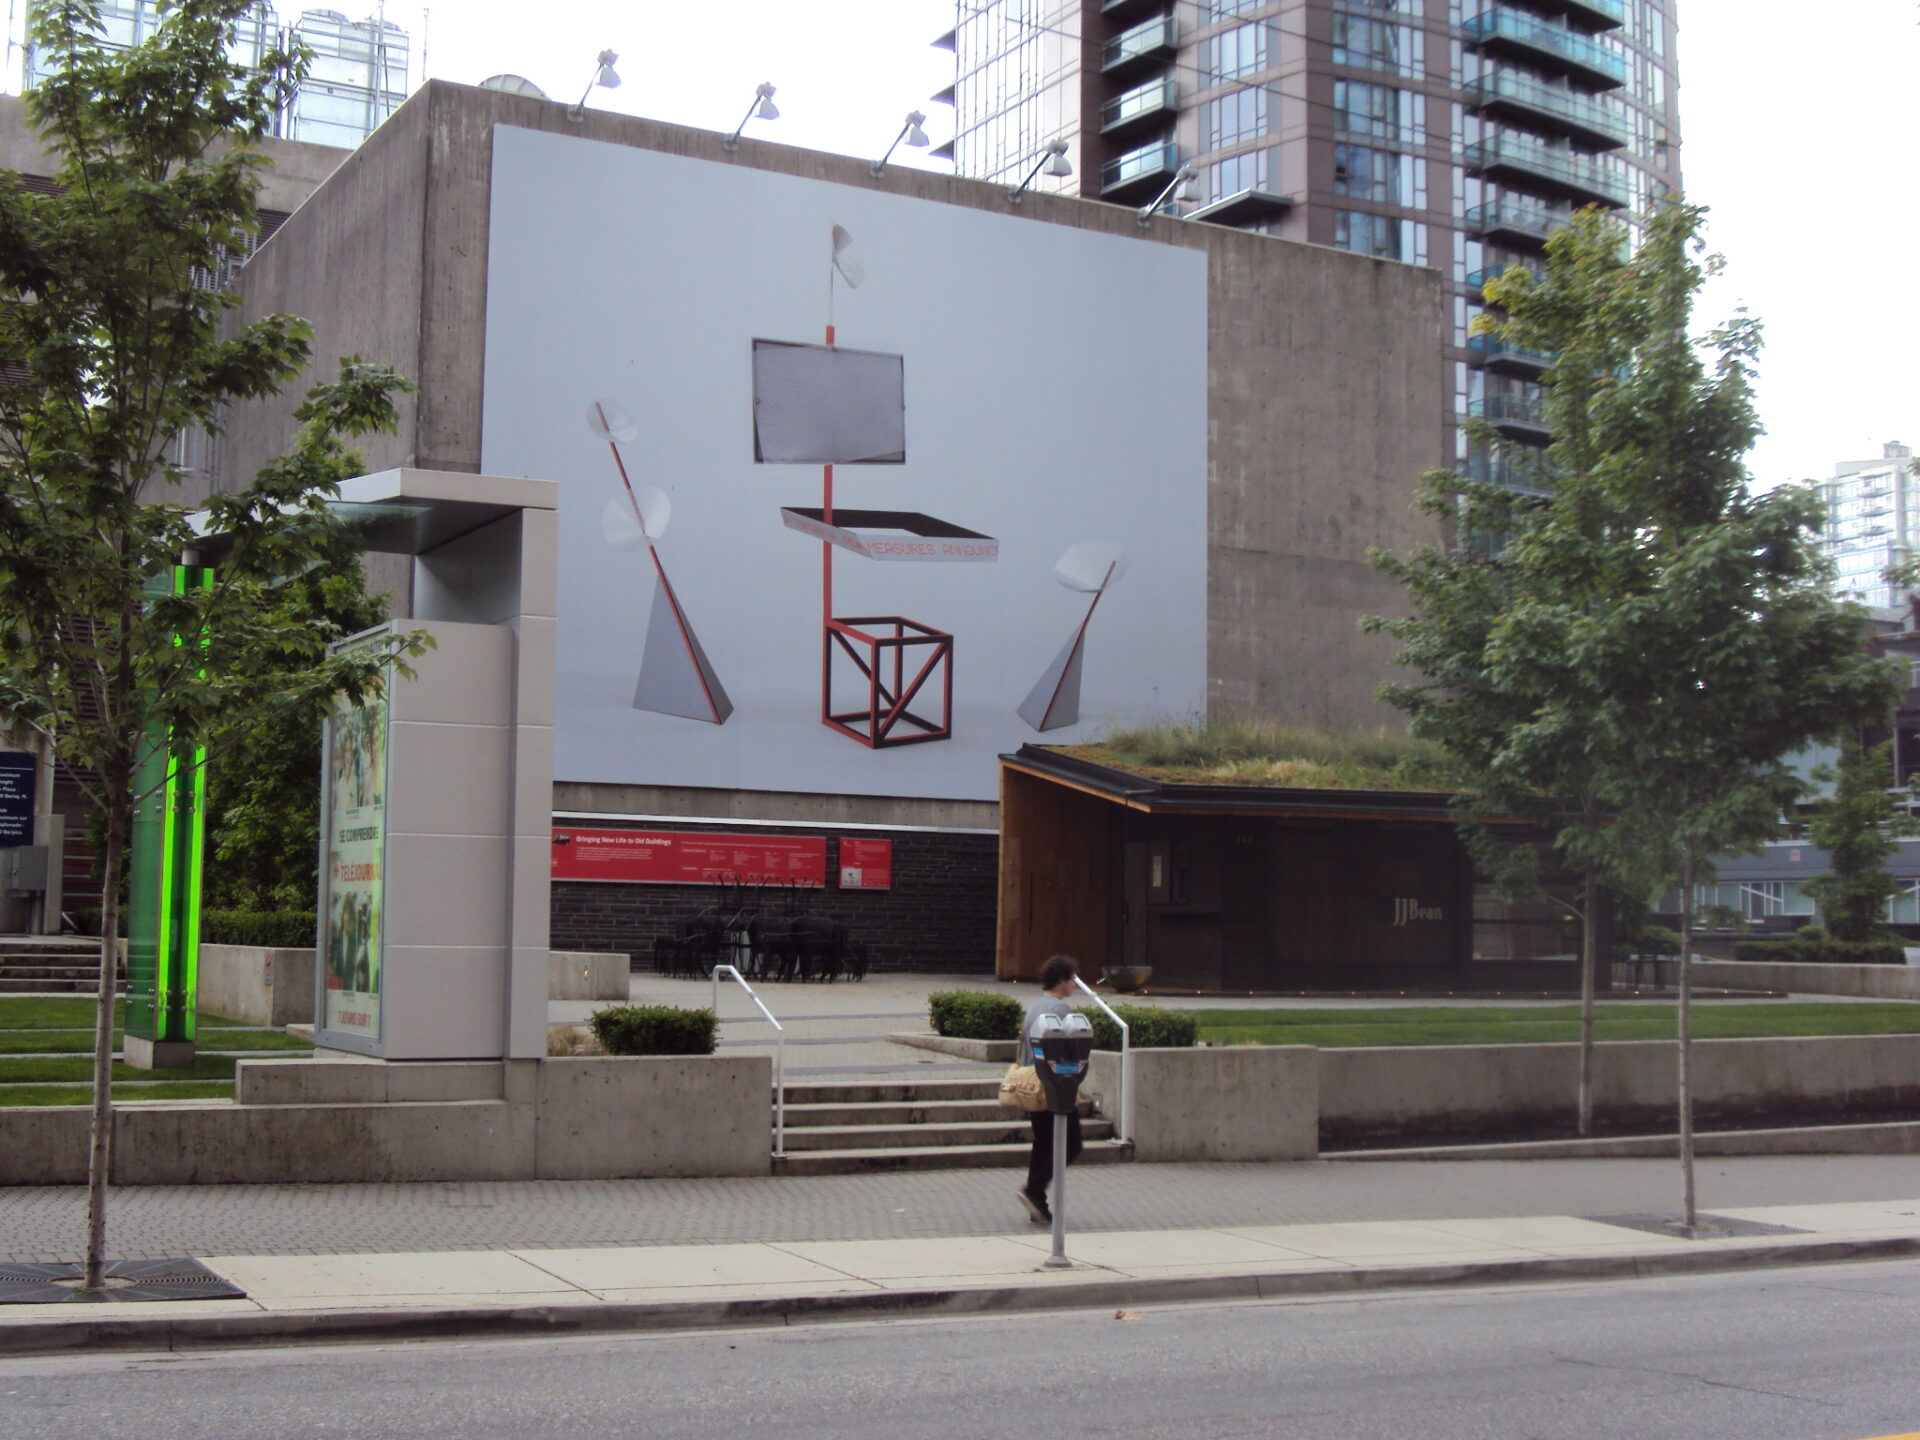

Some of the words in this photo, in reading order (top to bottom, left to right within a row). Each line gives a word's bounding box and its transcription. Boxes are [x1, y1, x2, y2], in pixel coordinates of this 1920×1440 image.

[575, 835, 601, 845] Bringing
[602, 836, 614, 844] New
[635, 837, 645, 845] Old
[645, 838, 672, 847] Buildings
